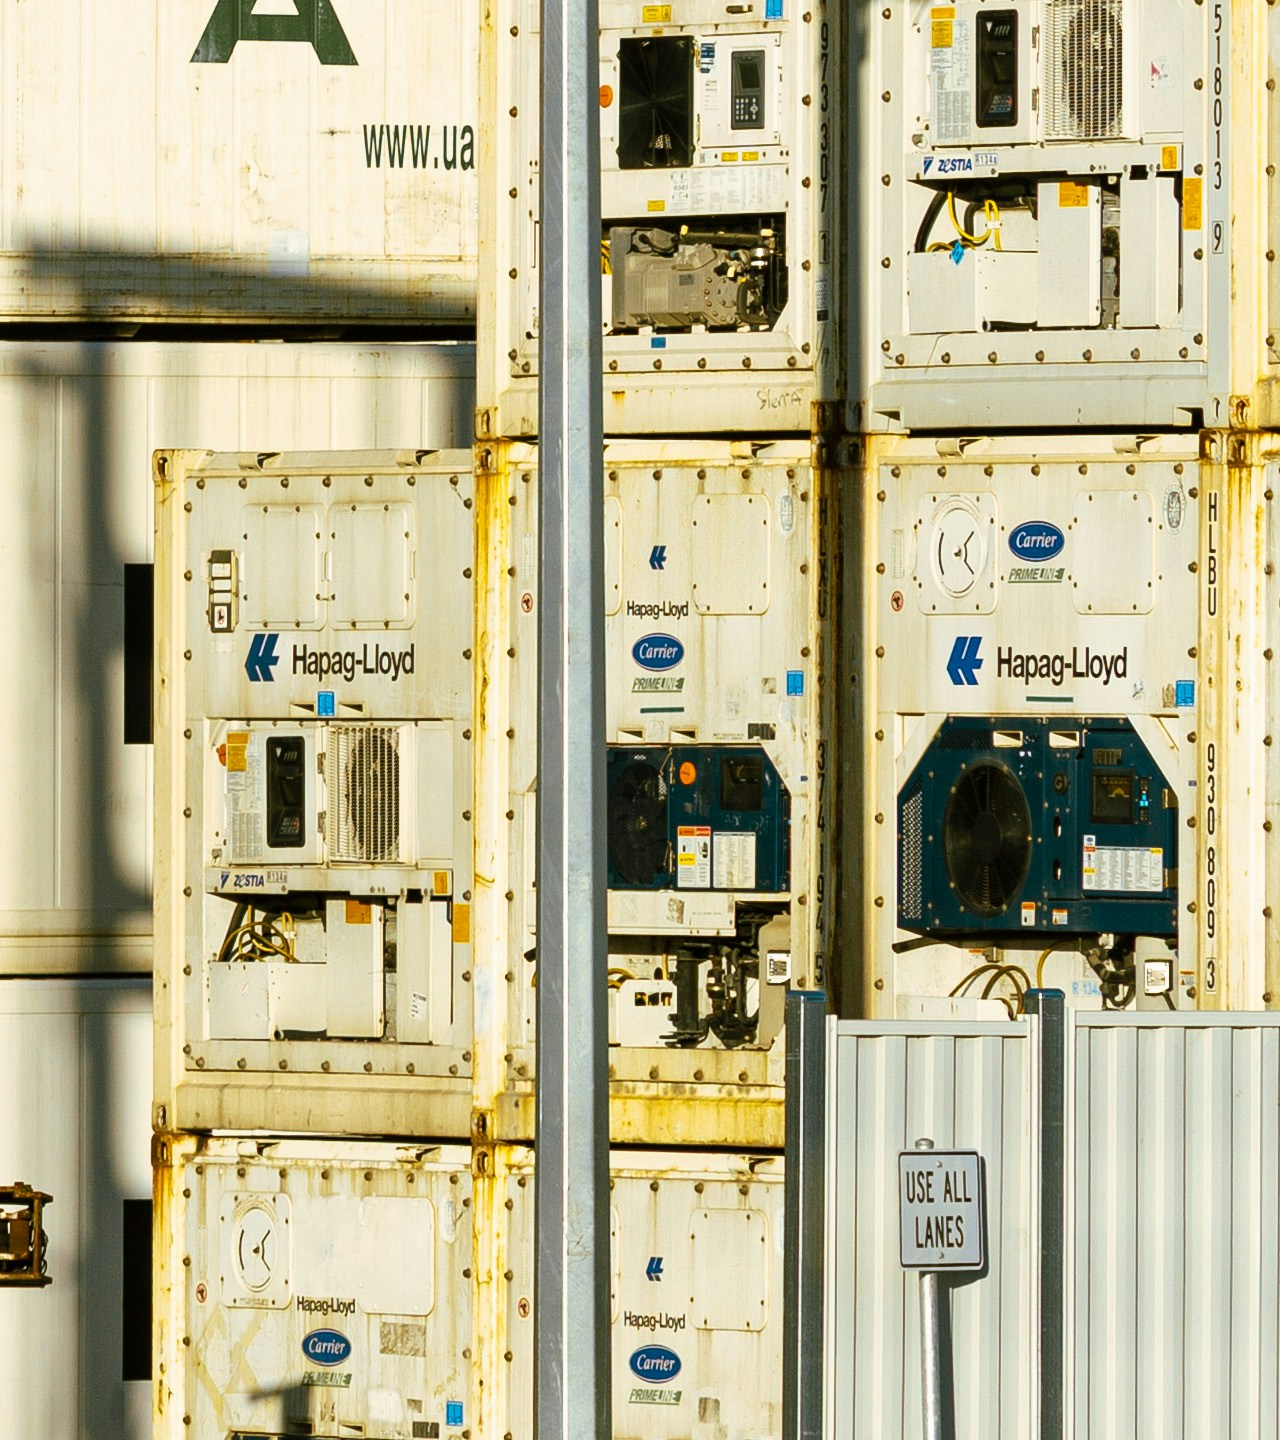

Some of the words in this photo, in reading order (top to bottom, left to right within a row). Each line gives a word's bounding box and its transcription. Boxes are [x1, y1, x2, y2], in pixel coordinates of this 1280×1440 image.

[1213, 3, 1224, 192] 518013
[1015, 530, 1058, 551] Carrier
[1207, 491, 1218, 617] HLBU
[626, 600, 689, 619] Hapag-Lloyd
[291, 642, 415, 682] Hapag-Lloyd
[639, 643, 679, 662] Carrier
[996, 646, 1128, 687] Hapag-Lloyd
[1206, 743, 1216, 836] 930
[1206, 847, 1216, 939] 809
[906, 1171, 936, 1205] USE
[943, 1171, 972, 1205] ALL
[915, 1216, 965, 1250] LANES
[296, 1295, 356, 1316] Hapag-Lloyd
[623, 1310, 686, 1331] Hapag-Lloyd
[308, 1337, 346, 1357] Carrier
[634, 1353, 676, 1375] Carrier
